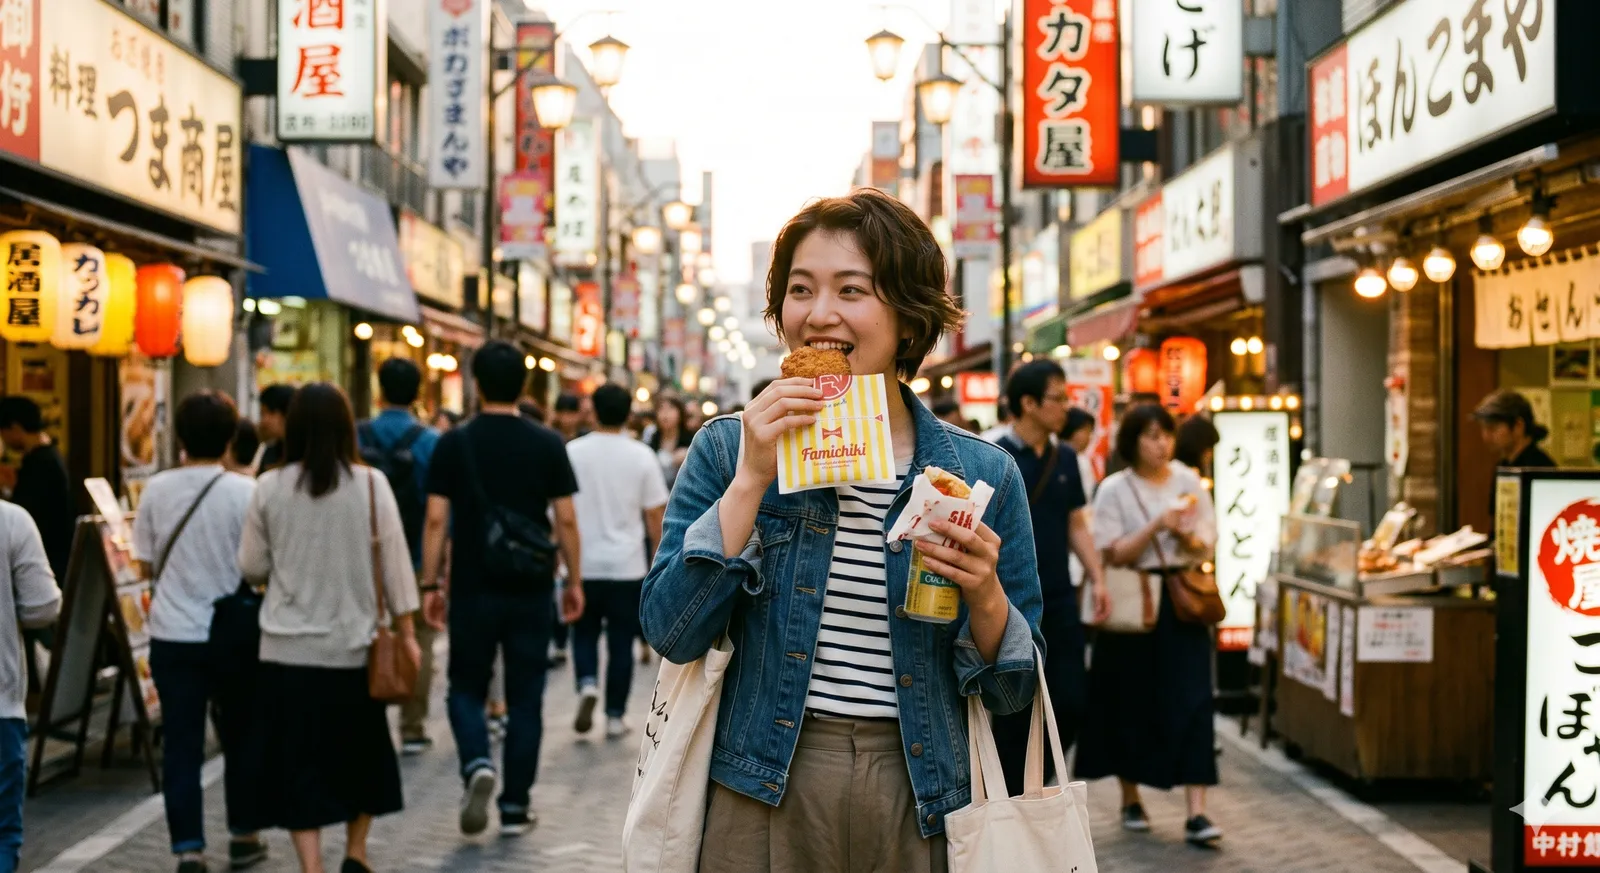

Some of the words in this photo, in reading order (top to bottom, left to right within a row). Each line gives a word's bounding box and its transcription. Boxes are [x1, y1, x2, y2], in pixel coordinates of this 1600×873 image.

[50, 45, 97, 120] 料理
[291, 0, 345, 99] 酒屋
[801, 442, 866, 462] Famichiki
